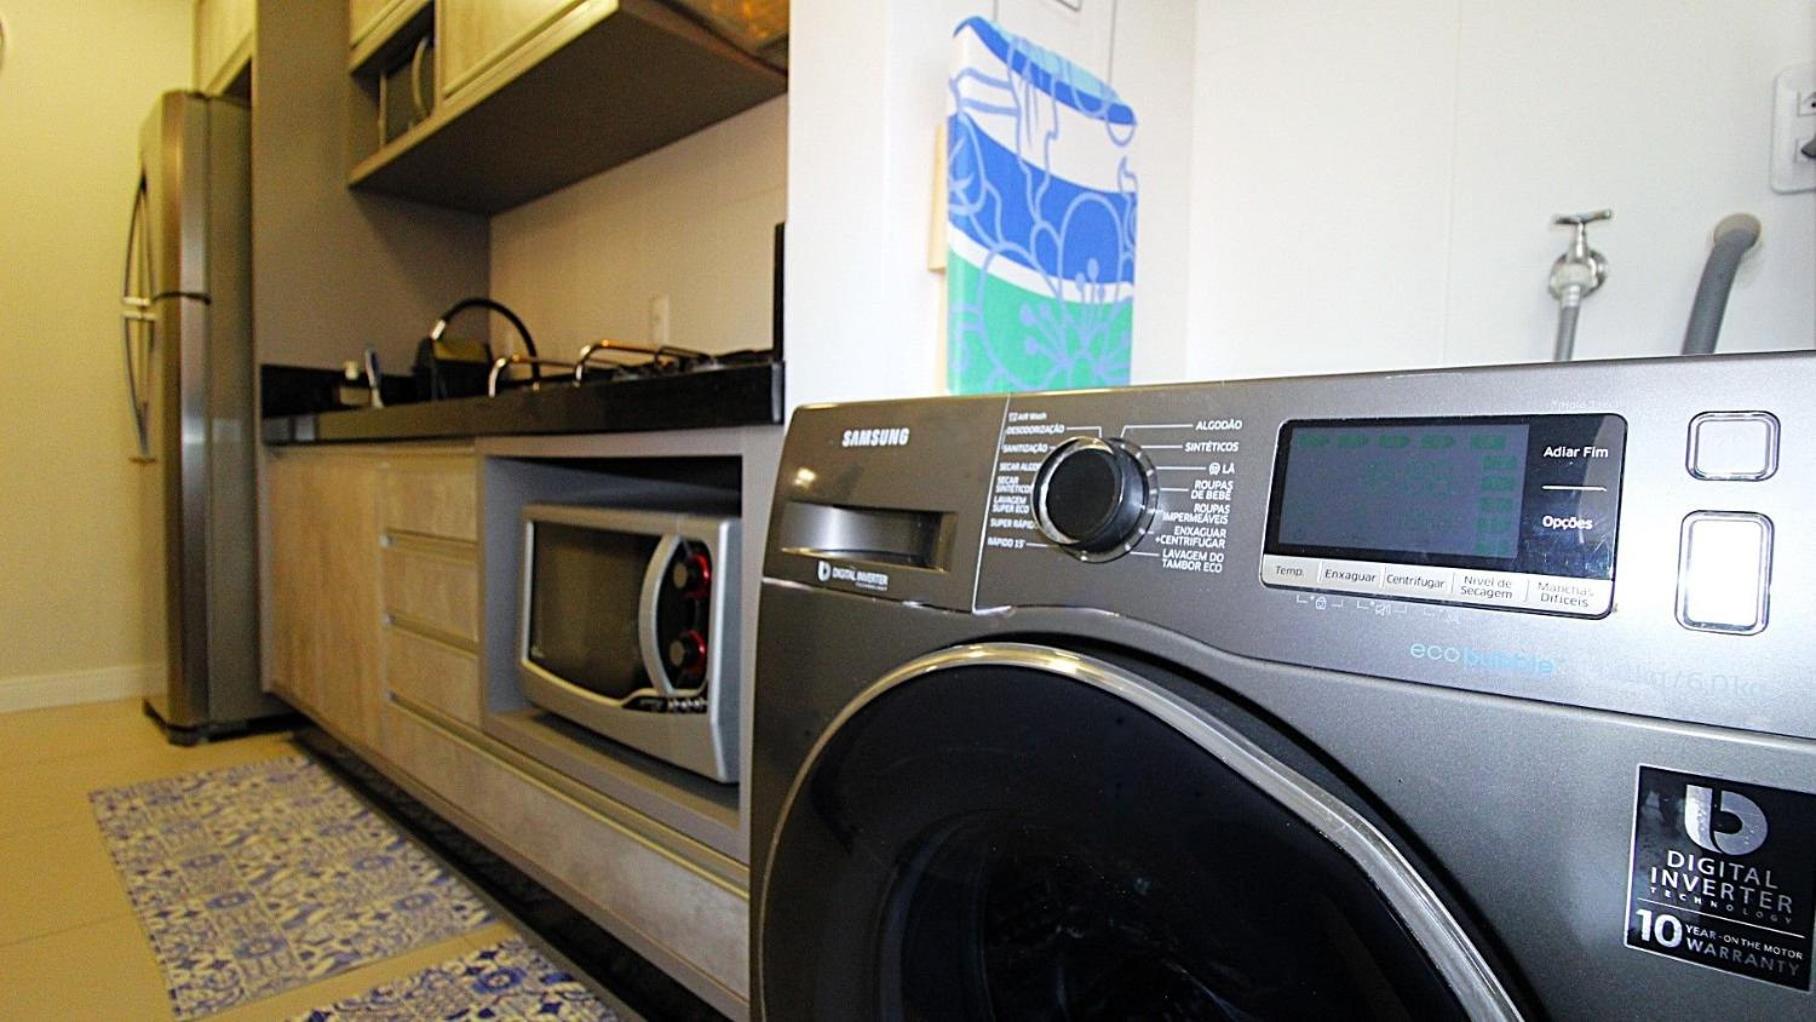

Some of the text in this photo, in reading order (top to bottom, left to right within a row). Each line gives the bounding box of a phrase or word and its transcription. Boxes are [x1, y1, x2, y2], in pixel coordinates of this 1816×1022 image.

[1195, 418, 1243, 430] ALGODÃO
[841, 428, 910, 447] SAMSUNG
[1185, 440, 1240, 452] SINTÉTICOS
[1543, 446, 1609, 458] Adiar Fim
[999, 462, 1020, 471] SECAR
[1222, 462, 1236, 474] LÃ
[995, 484, 1033, 494] SINTÉTICO
[1194, 480, 1234, 490] ROUPAS
[1191, 488, 1233, 500] DE BEBÊ
[992, 504, 1030, 514] SUPER ECO
[1193, 503, 1231, 514] ROUPAS
[990, 518, 1013, 528] SUPER
[1162, 511, 1229, 525] IMPERMEÁVEIS
[1542, 515, 1593, 530] Opções
[1174, 525, 1227, 539] ENXAGUAR
[987, 536, 1014, 548] RÁPIDO
[1162, 548, 1225, 563] LAVAGEM DO
[1162, 558, 1223, 573] TAMBOR ECO
[1275, 566, 1305, 578] Temp.
[1325, 568, 1377, 583] Enxaguar
[1386, 573, 1446, 589] Centrifugar
[1497, 577, 1512, 588] de
[1460, 585, 1513, 600] Secagem
[1666, 850, 1779, 889] DIGITAL
[1650, 866, 1793, 914] INVERTER
[1650, 886, 1792, 925] TECHNOLOGY
[1636, 908, 1683, 948] 10
[1686, 936, 1800, 976] WARRANTY
[1741, 938, 1761, 951] THE
[1763, 943, 1804, 960] MOTOR
